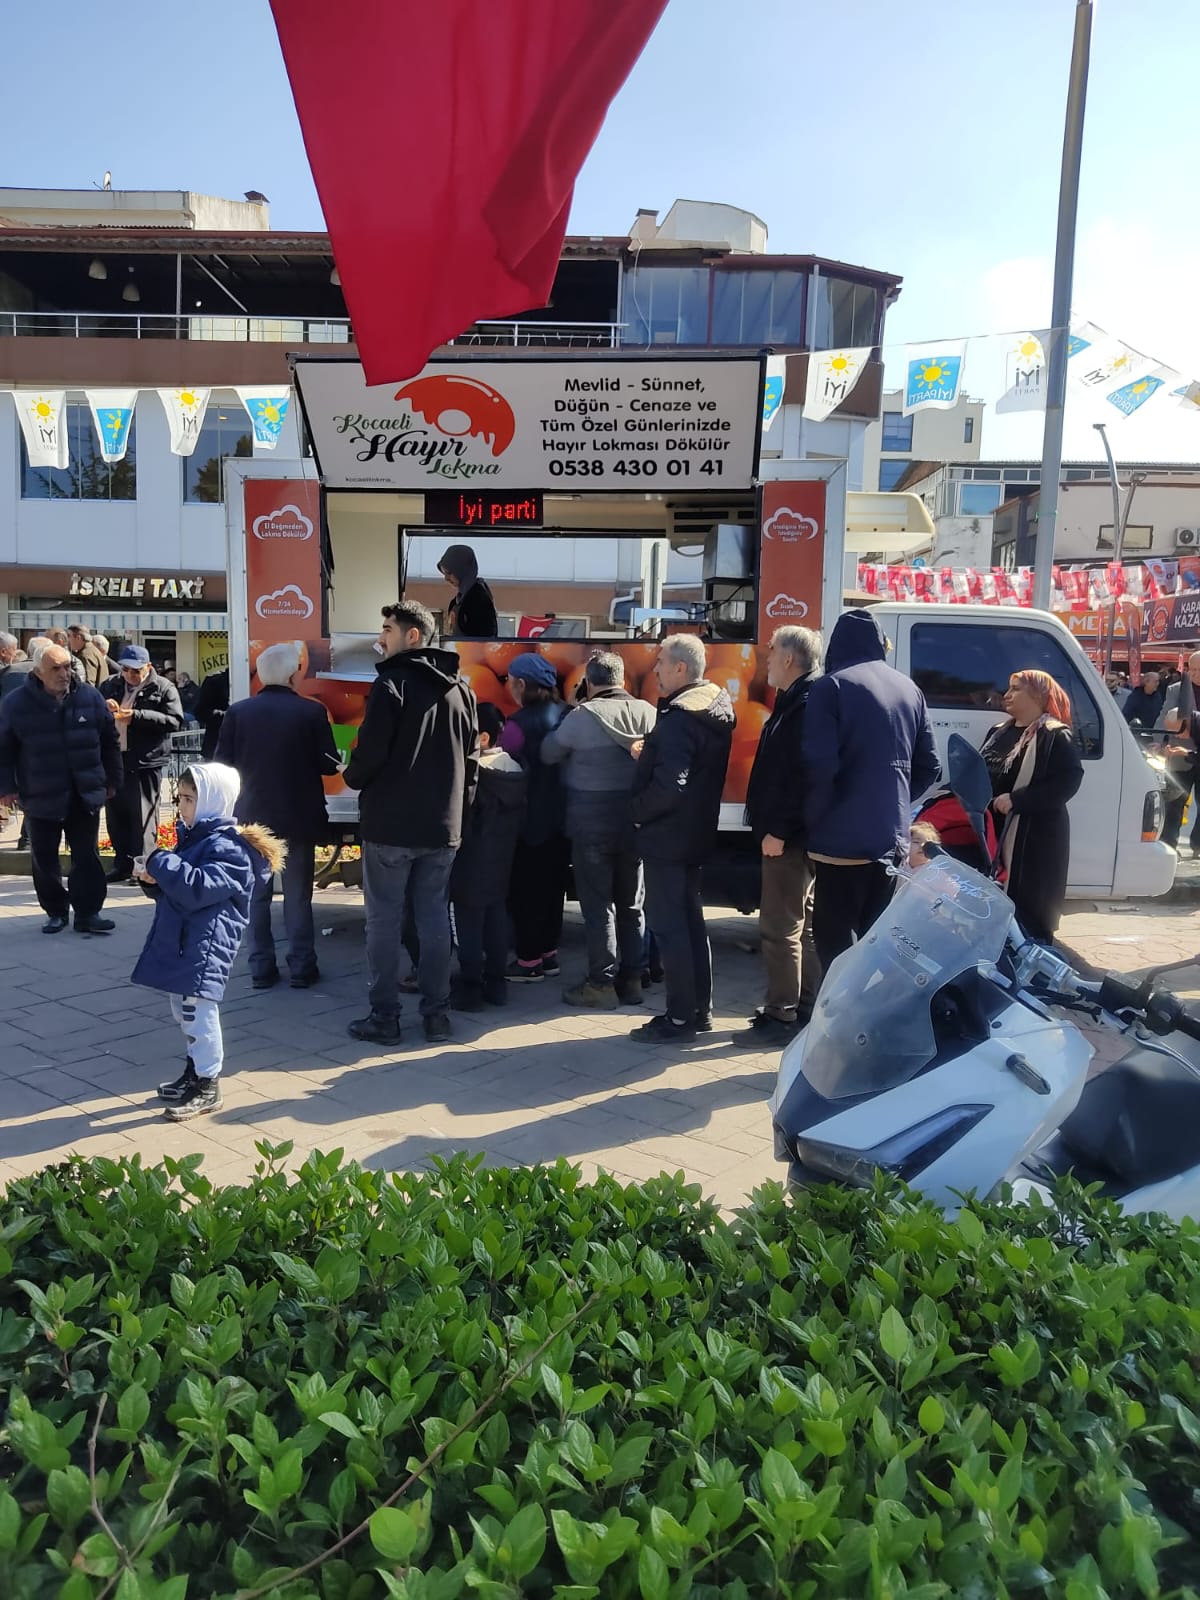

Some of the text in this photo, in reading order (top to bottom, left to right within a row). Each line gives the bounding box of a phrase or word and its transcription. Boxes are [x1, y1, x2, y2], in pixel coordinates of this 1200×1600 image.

[565, 378, 620, 391] Mevlid
[641, 378, 705, 393] Sünnet,
[554, 398, 610, 415] Düğün
[630, 399, 692, 411] Cenaze
[698, 401, 717, 411] ve
[332, 413, 413, 437] Kocaeli
[540, 416, 731, 432] Tüm Özel Günlerinizde
[349, 430, 468, 465] Hayır
[542, 438, 731, 454] Hayır Lokması Dökülür
[426, 458, 502, 479] Lokma
[549, 459, 723, 476] 0538 430 01 41
[460, 495, 536, 525] İyi parti
[69, 572, 145, 598] İSKELE
[1068, 615, 1127, 632] MEA
